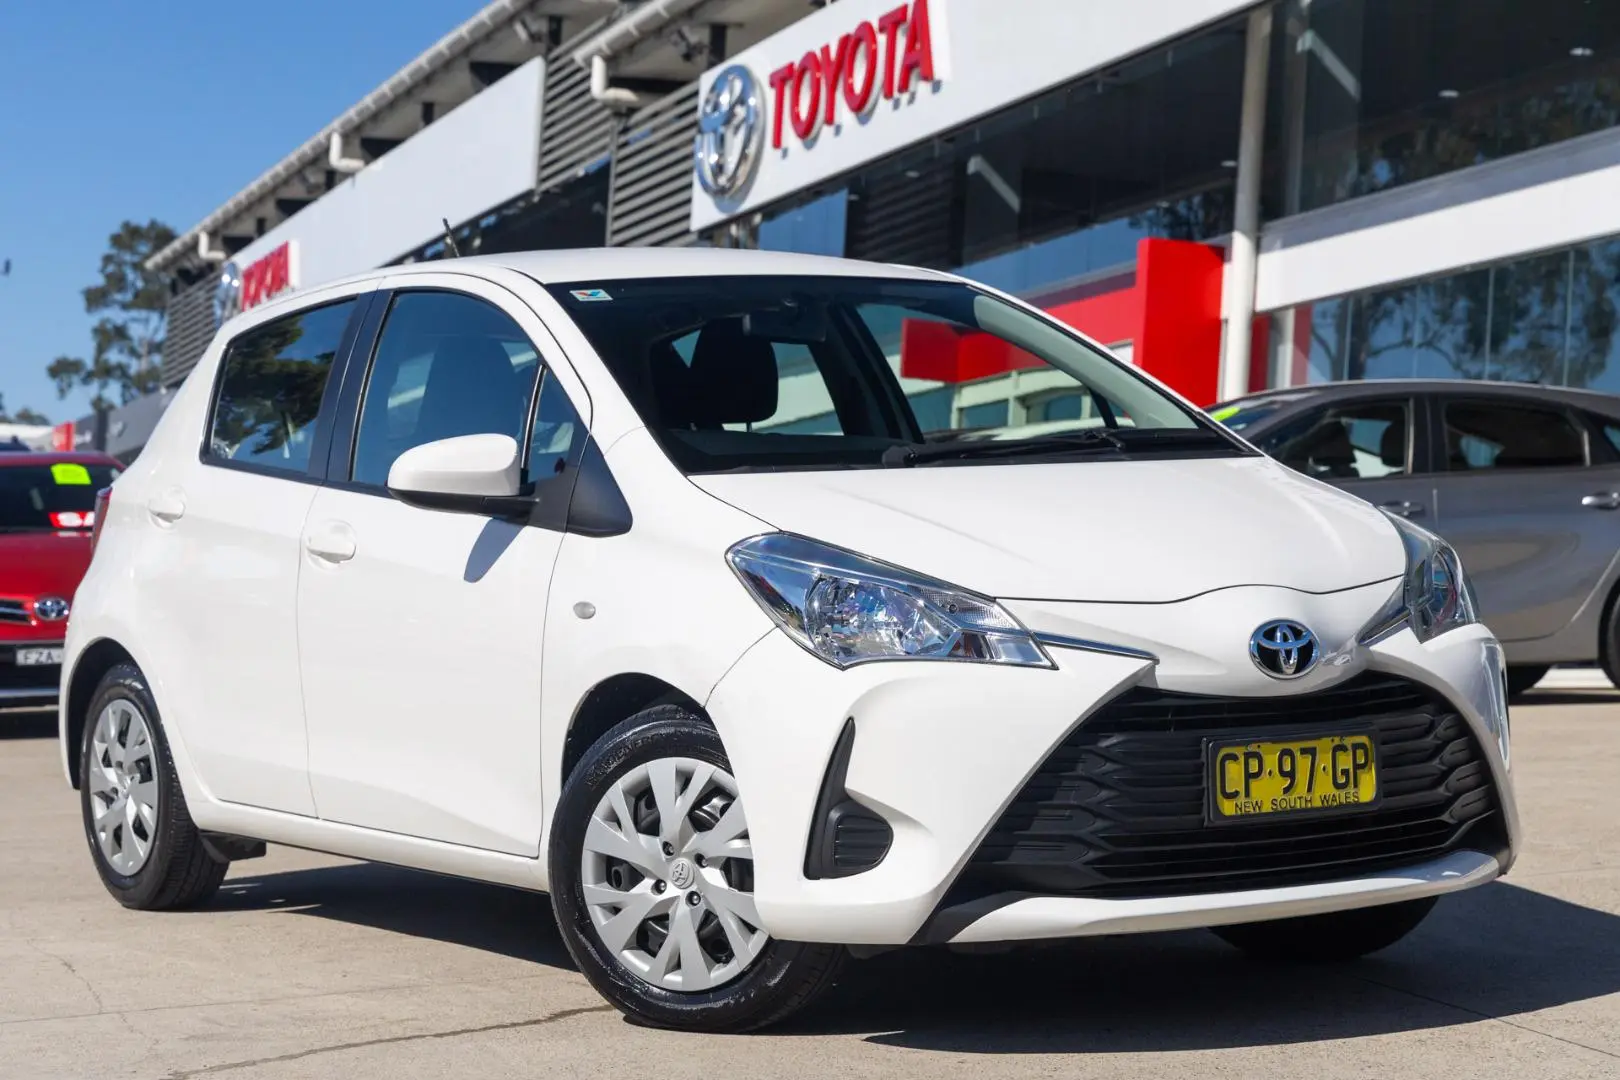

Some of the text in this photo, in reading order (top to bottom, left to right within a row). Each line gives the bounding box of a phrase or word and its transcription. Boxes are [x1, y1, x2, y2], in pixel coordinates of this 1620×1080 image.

[769, 0, 934, 149] TOYOTA
[1234, 791, 1360, 814] NEW SOUTH WALES
